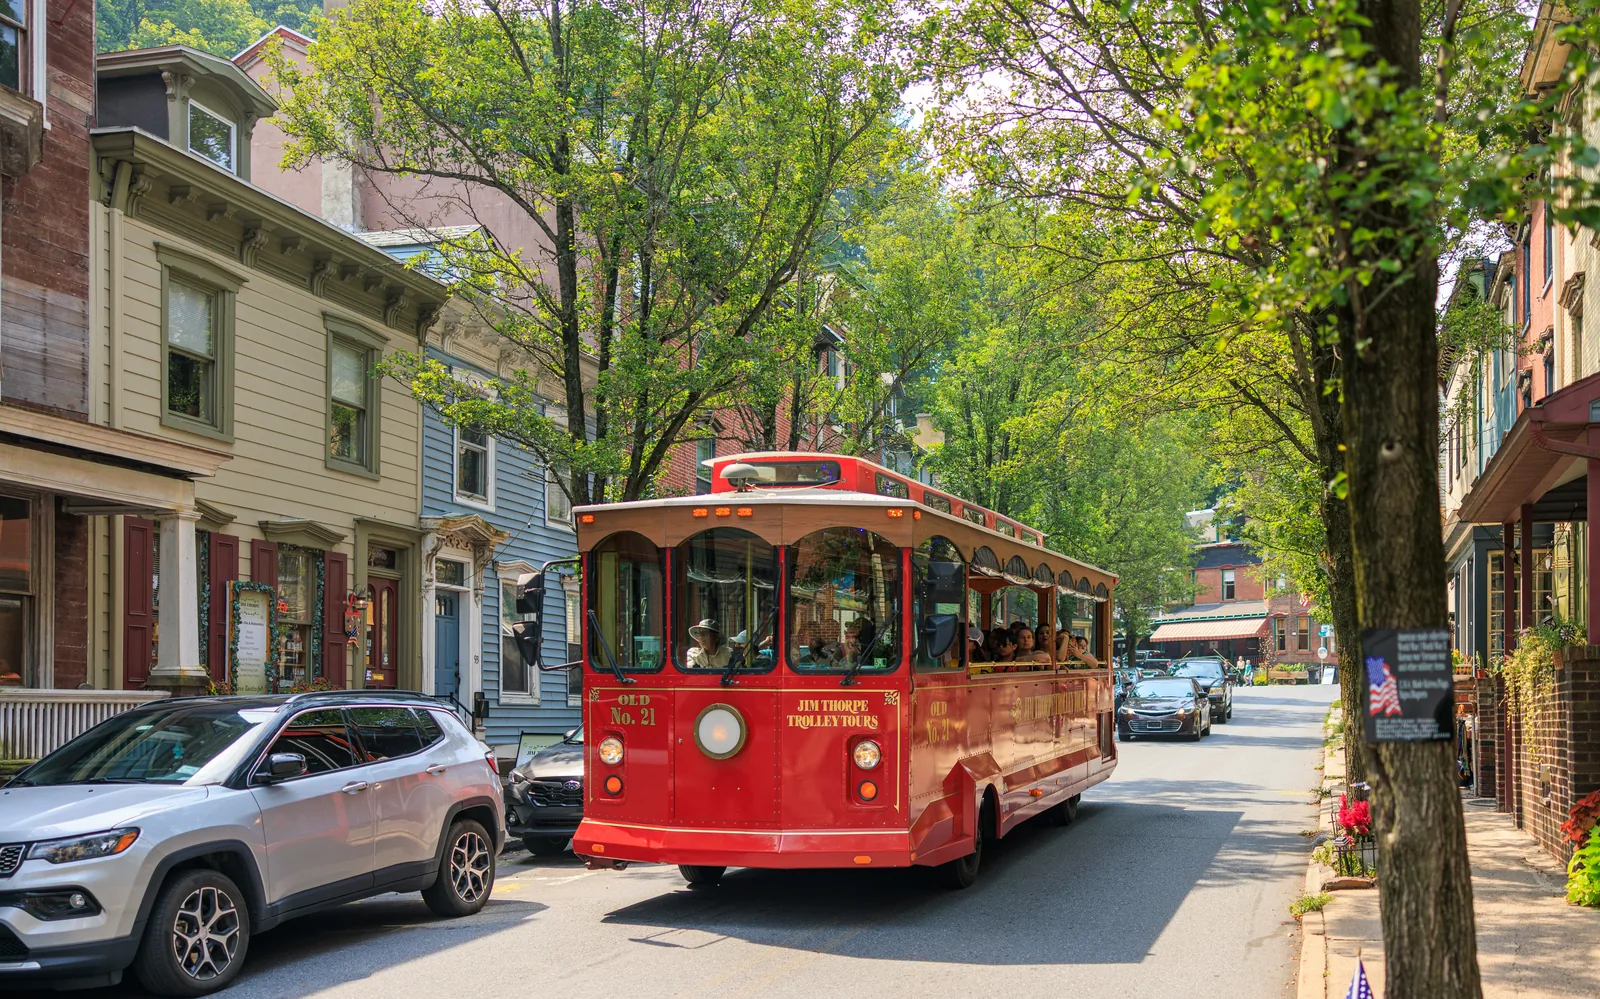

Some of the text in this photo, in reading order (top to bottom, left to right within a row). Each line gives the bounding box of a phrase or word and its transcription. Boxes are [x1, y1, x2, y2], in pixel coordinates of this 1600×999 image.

[617, 694, 651, 706] OLD
[797, 699, 869, 714] JIM THORPE
[610, 706, 656, 726] No. 21
[930, 701, 948, 717] OLD
[786, 714, 879, 729] TROLLEY TOURS
[926, 718, 949, 744] No. 21
